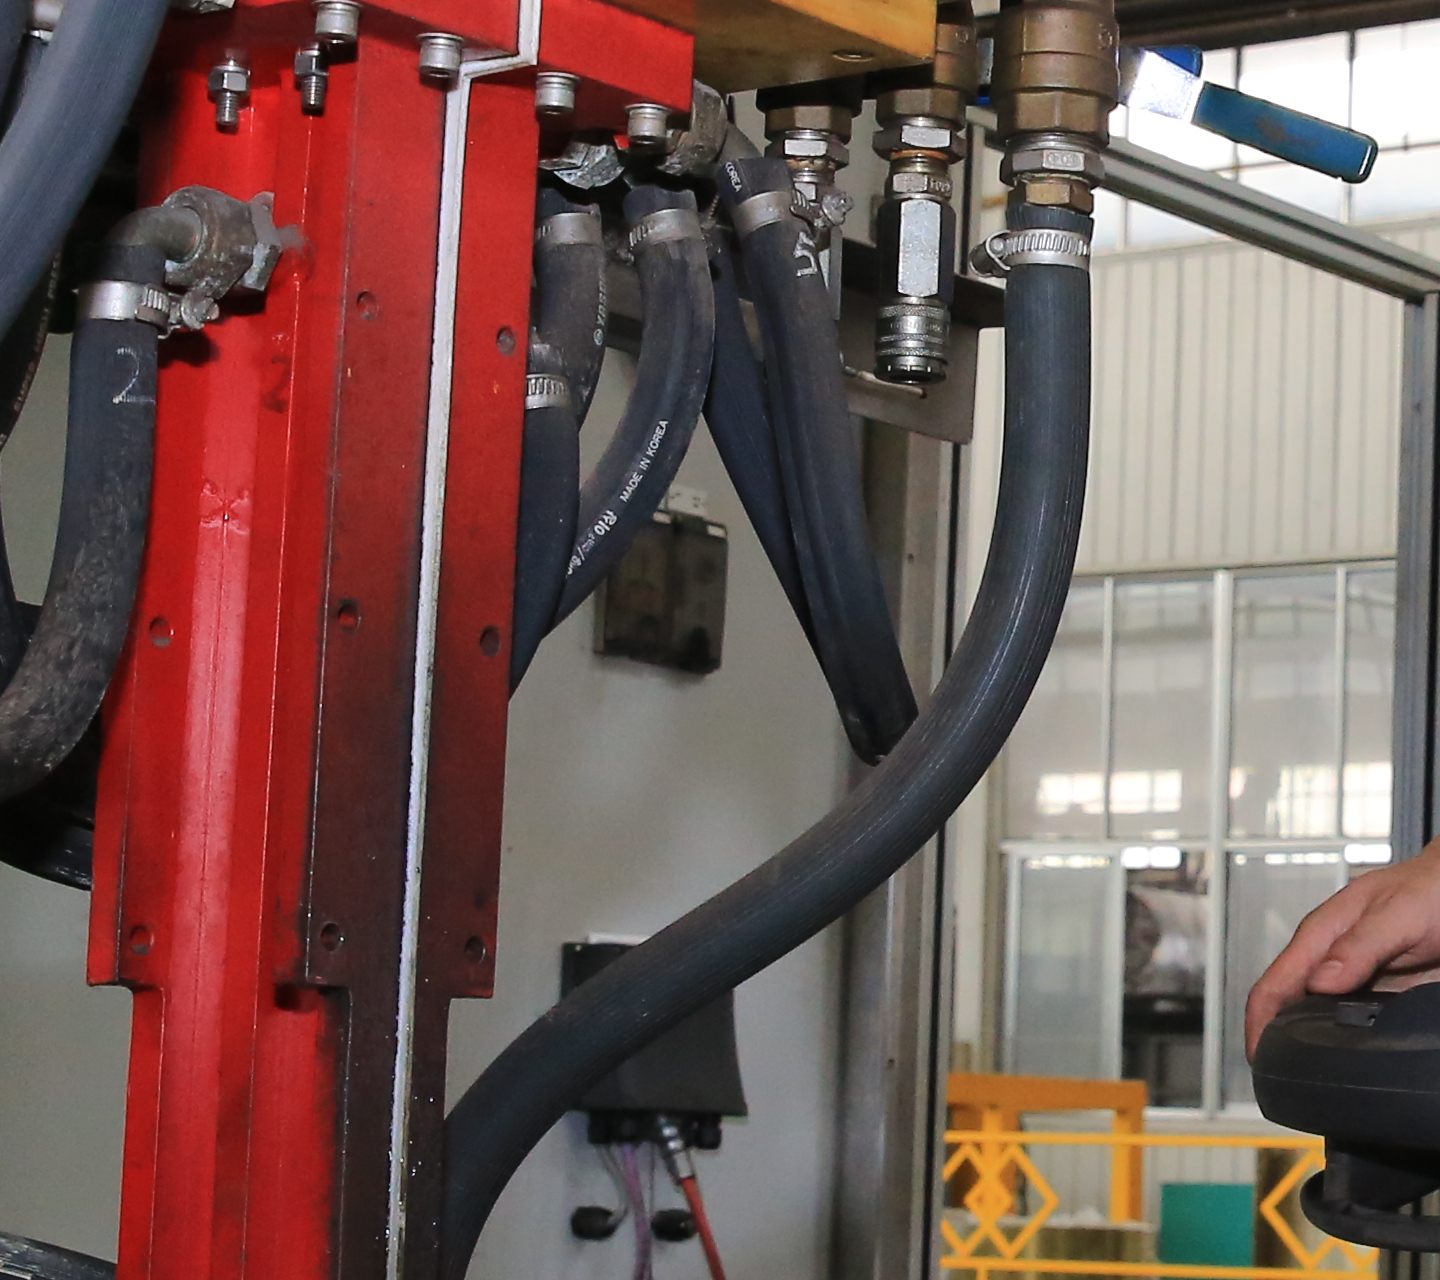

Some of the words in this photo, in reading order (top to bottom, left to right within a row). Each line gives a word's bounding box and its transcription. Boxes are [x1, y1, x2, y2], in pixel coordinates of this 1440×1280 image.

[112, 346, 156, 405] 2
[619, 472, 643, 503] MADE
[639, 456, 652, 471] IN
[646, 420, 669, 458] KOREA
